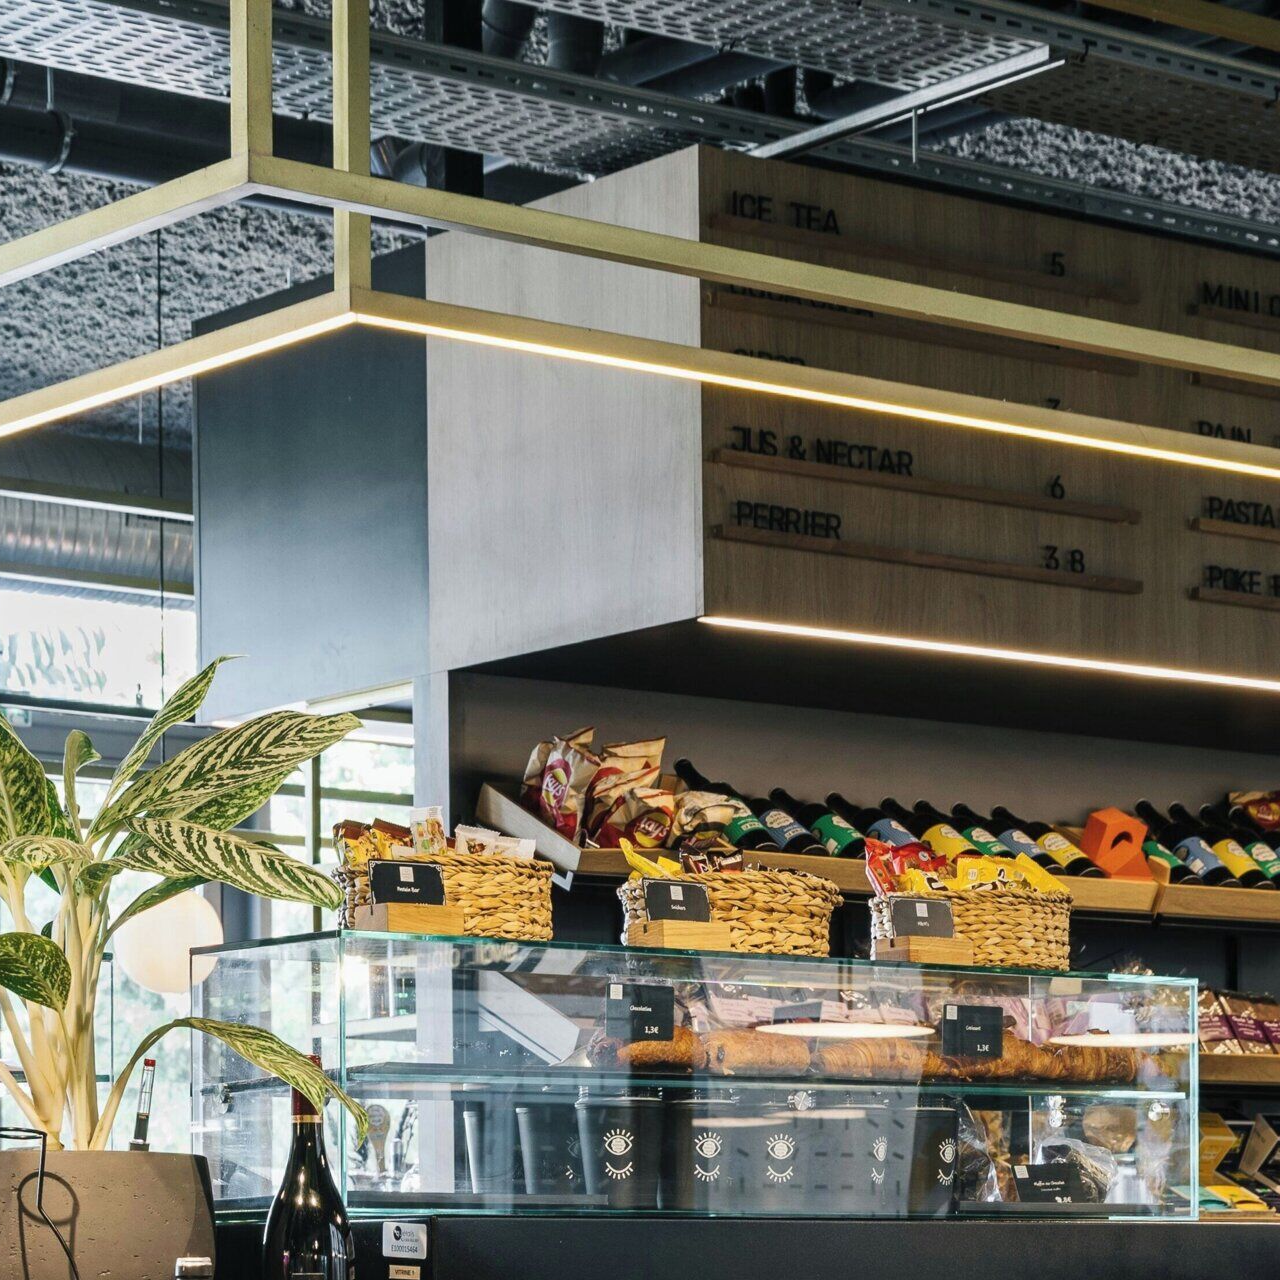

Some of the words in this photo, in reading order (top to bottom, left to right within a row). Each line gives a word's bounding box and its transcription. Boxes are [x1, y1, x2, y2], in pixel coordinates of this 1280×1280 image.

[731, 190, 773, 222] ICE
[789, 202, 840, 235] TEA
[1050, 252, 1066, 277] 5
[1202, 281, 1260, 314] MINI
[731, 425, 778, 456] JUS
[789, 435, 807, 461] &
[815, 437, 914, 477] NECTAR
[1050, 475, 1066, 499] 6
[736, 500, 842, 540] PERRIER
[1206, 497, 1276, 529] PASTA
[1206, 565, 1262, 595] POKE
[639, 817, 670, 839] Lay's
[644, 1026, 659, 1034] 1,3€
